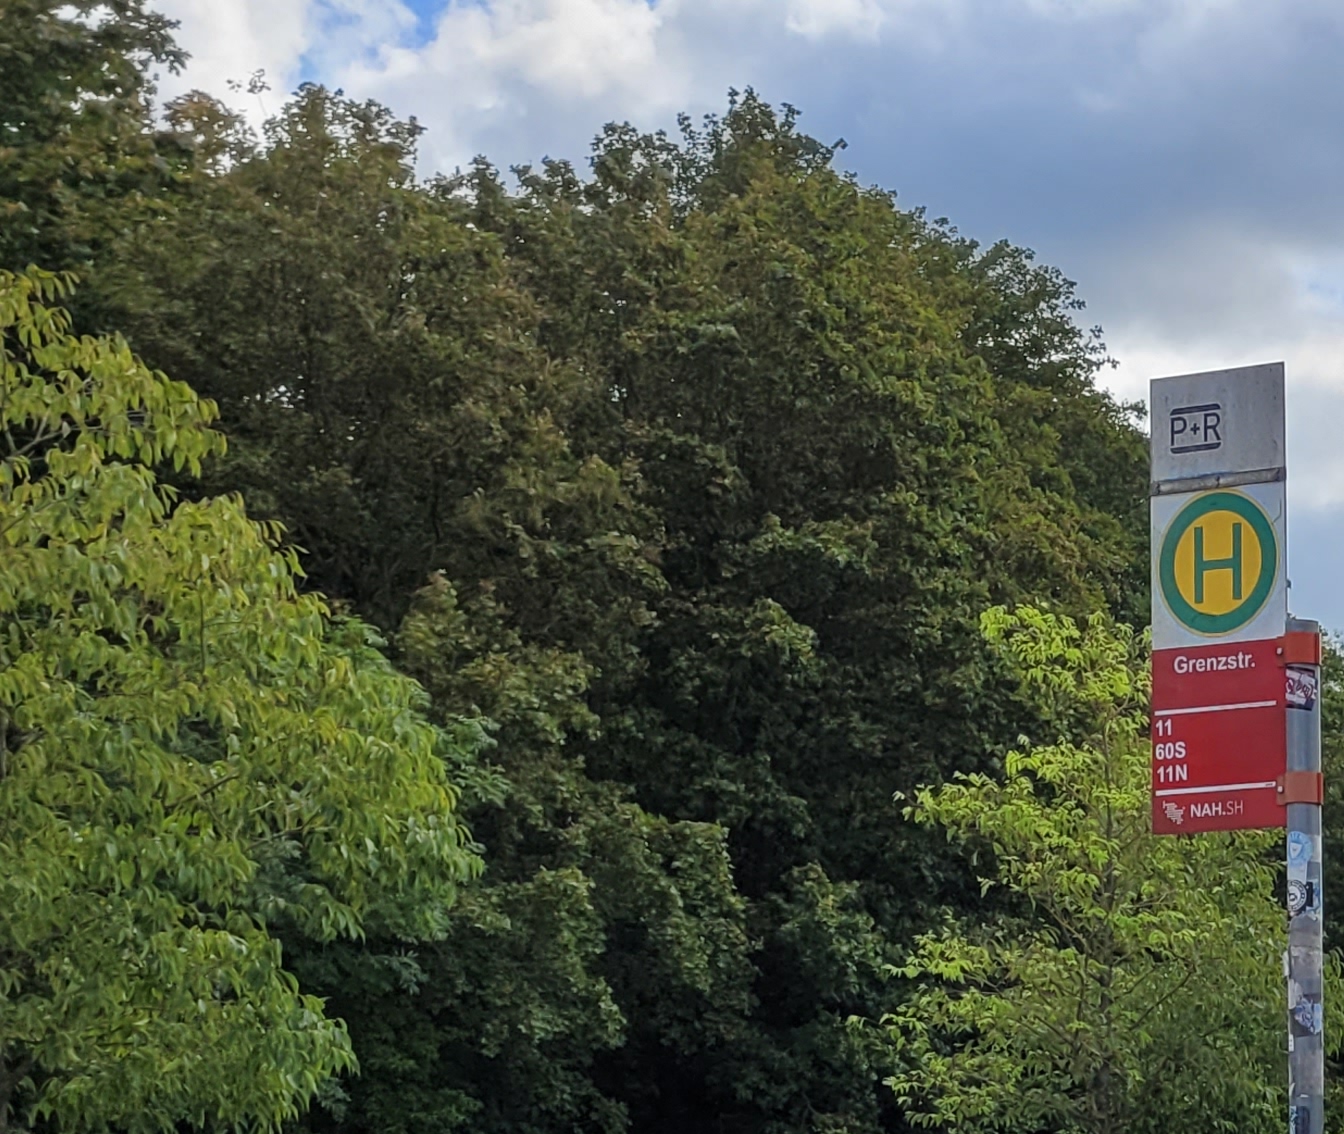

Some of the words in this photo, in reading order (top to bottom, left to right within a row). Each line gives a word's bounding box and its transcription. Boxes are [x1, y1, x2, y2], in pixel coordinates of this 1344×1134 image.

[1170, 411, 1221, 447] P+R
[1193, 522, 1242, 605] H
[1173, 650, 1256, 674] Grenzstr.
[1155, 718, 1172, 737] 11
[1155, 741, 1187, 760] 60S
[1156, 763, 1188, 783] 11N
[1190, 800, 1244, 818] NAH.SH
